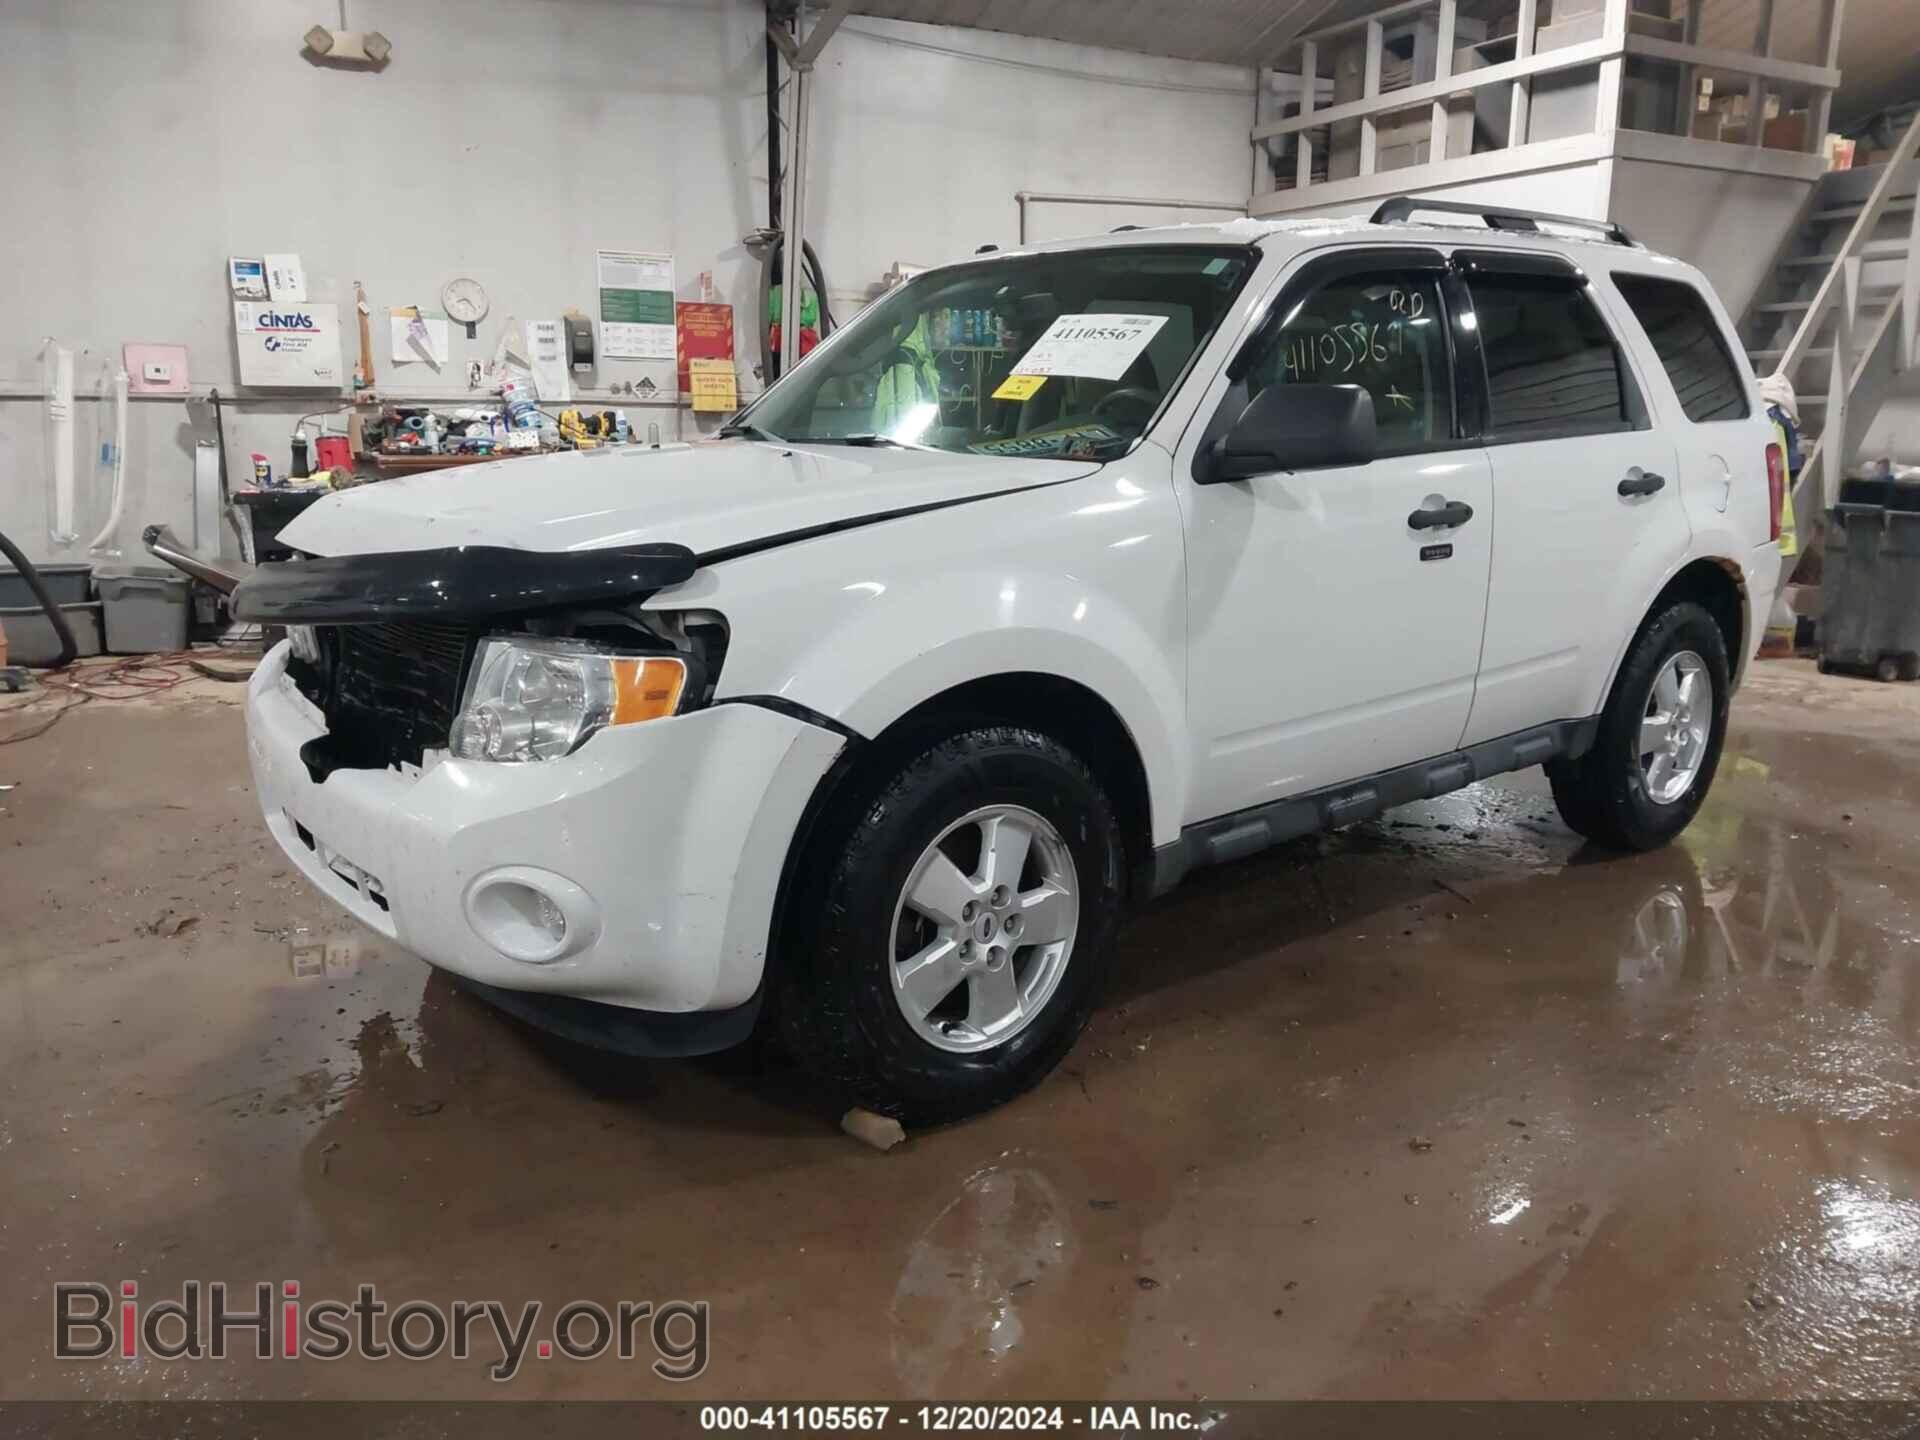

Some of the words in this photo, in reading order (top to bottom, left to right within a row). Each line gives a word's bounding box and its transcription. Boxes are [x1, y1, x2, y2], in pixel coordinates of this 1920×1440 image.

[258, 310, 313, 328] CINTAS
[1053, 327, 1142, 341] 41105567
[1284, 322, 1403, 380] 41105567
